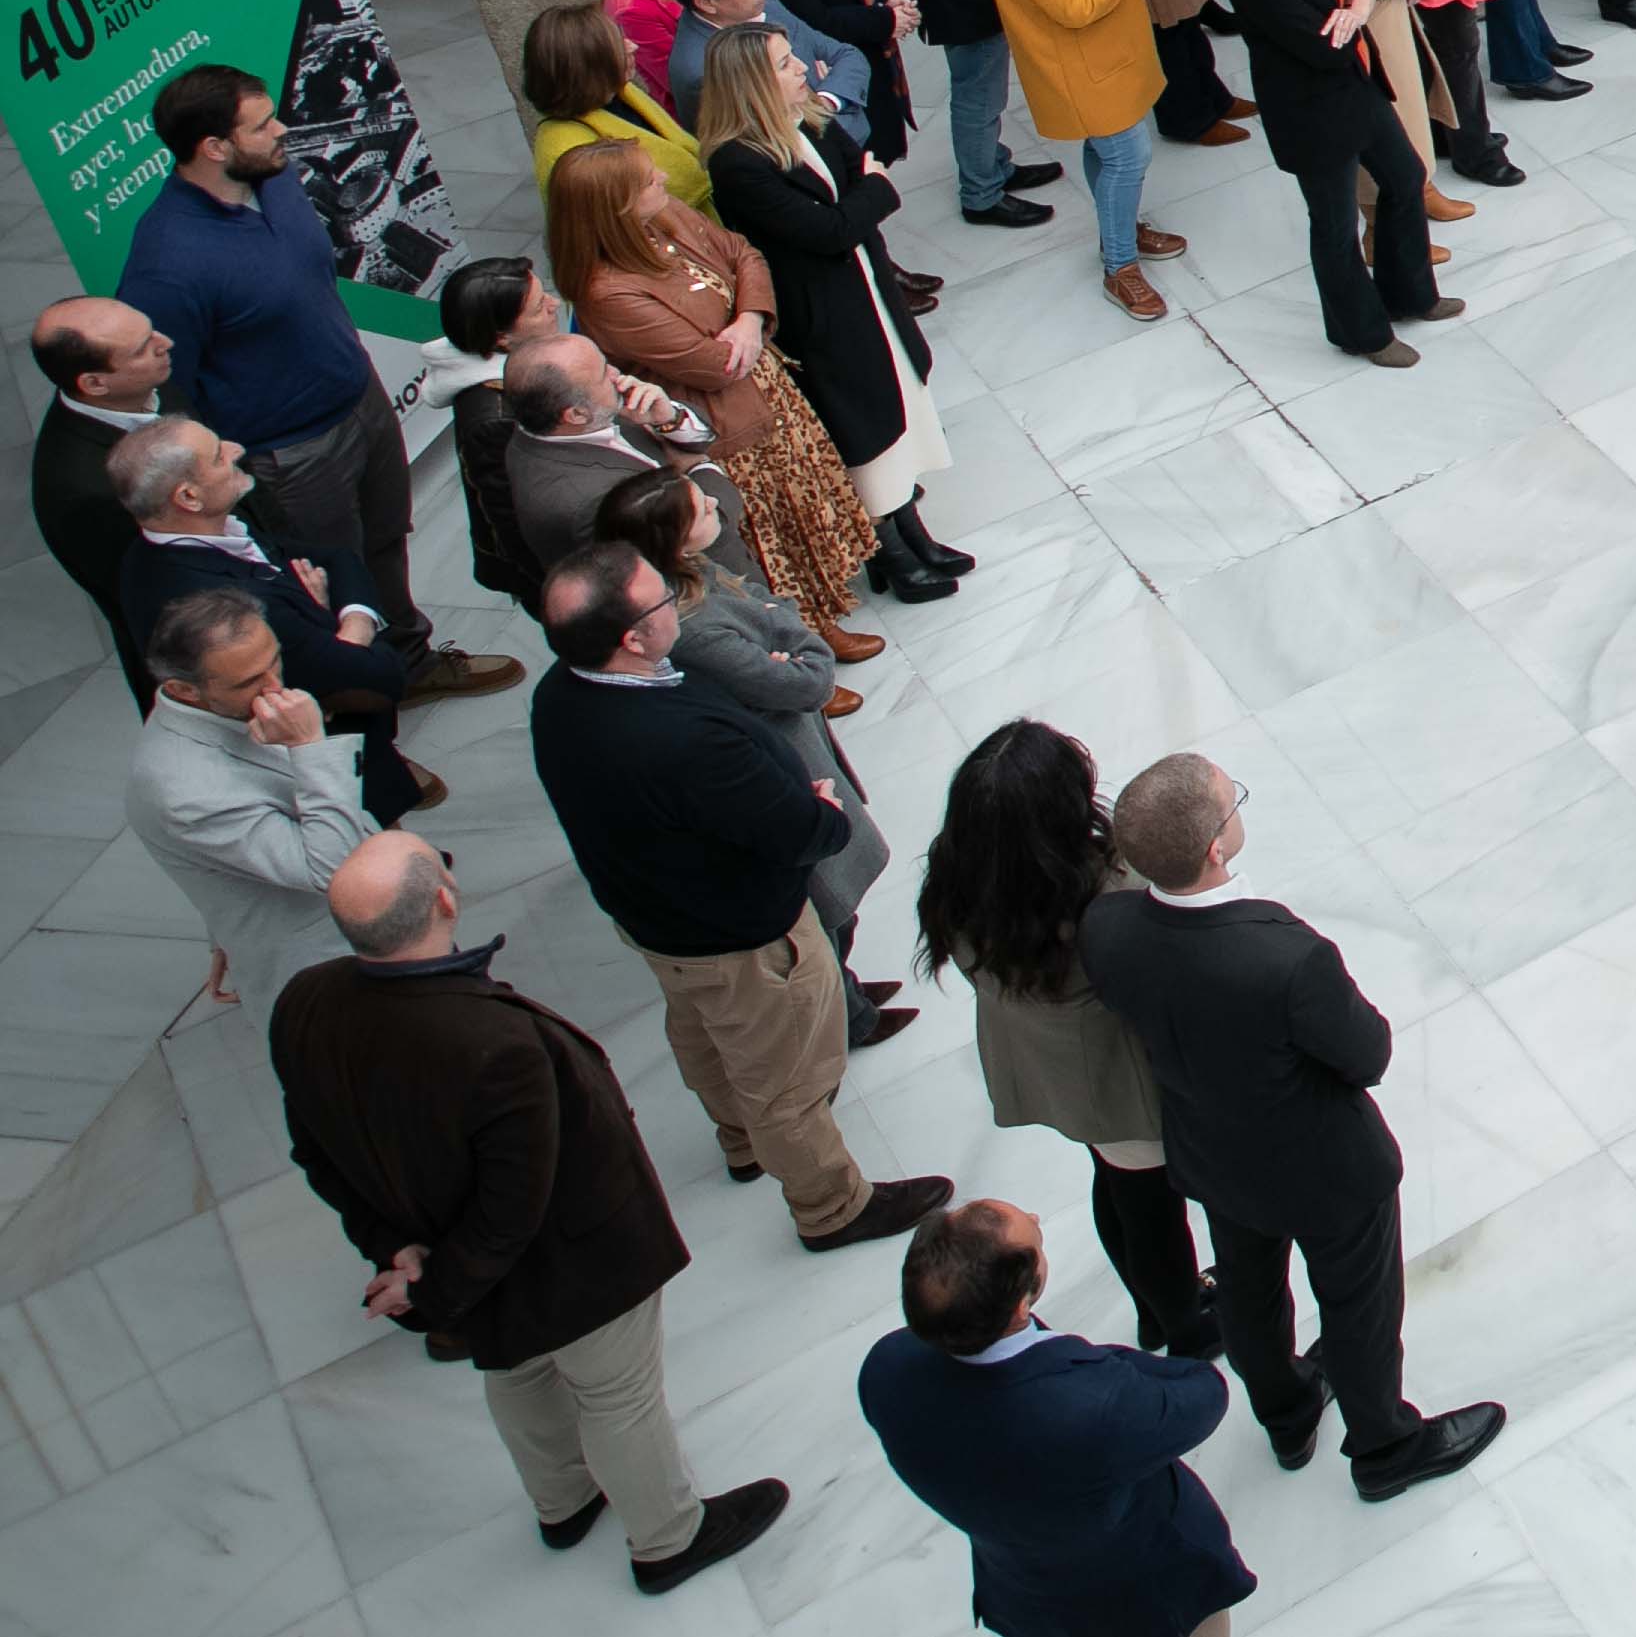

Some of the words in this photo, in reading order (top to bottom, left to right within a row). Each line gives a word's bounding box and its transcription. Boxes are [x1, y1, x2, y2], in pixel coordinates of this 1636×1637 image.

[49, 27, 212, 157] Extremadura,
[69, 138, 127, 193] ayer,
[121, 111, 156, 148] ho
[84, 202, 103, 235] y
[105, 146, 172, 213] siemp
[393, 367, 427, 414] HOY
